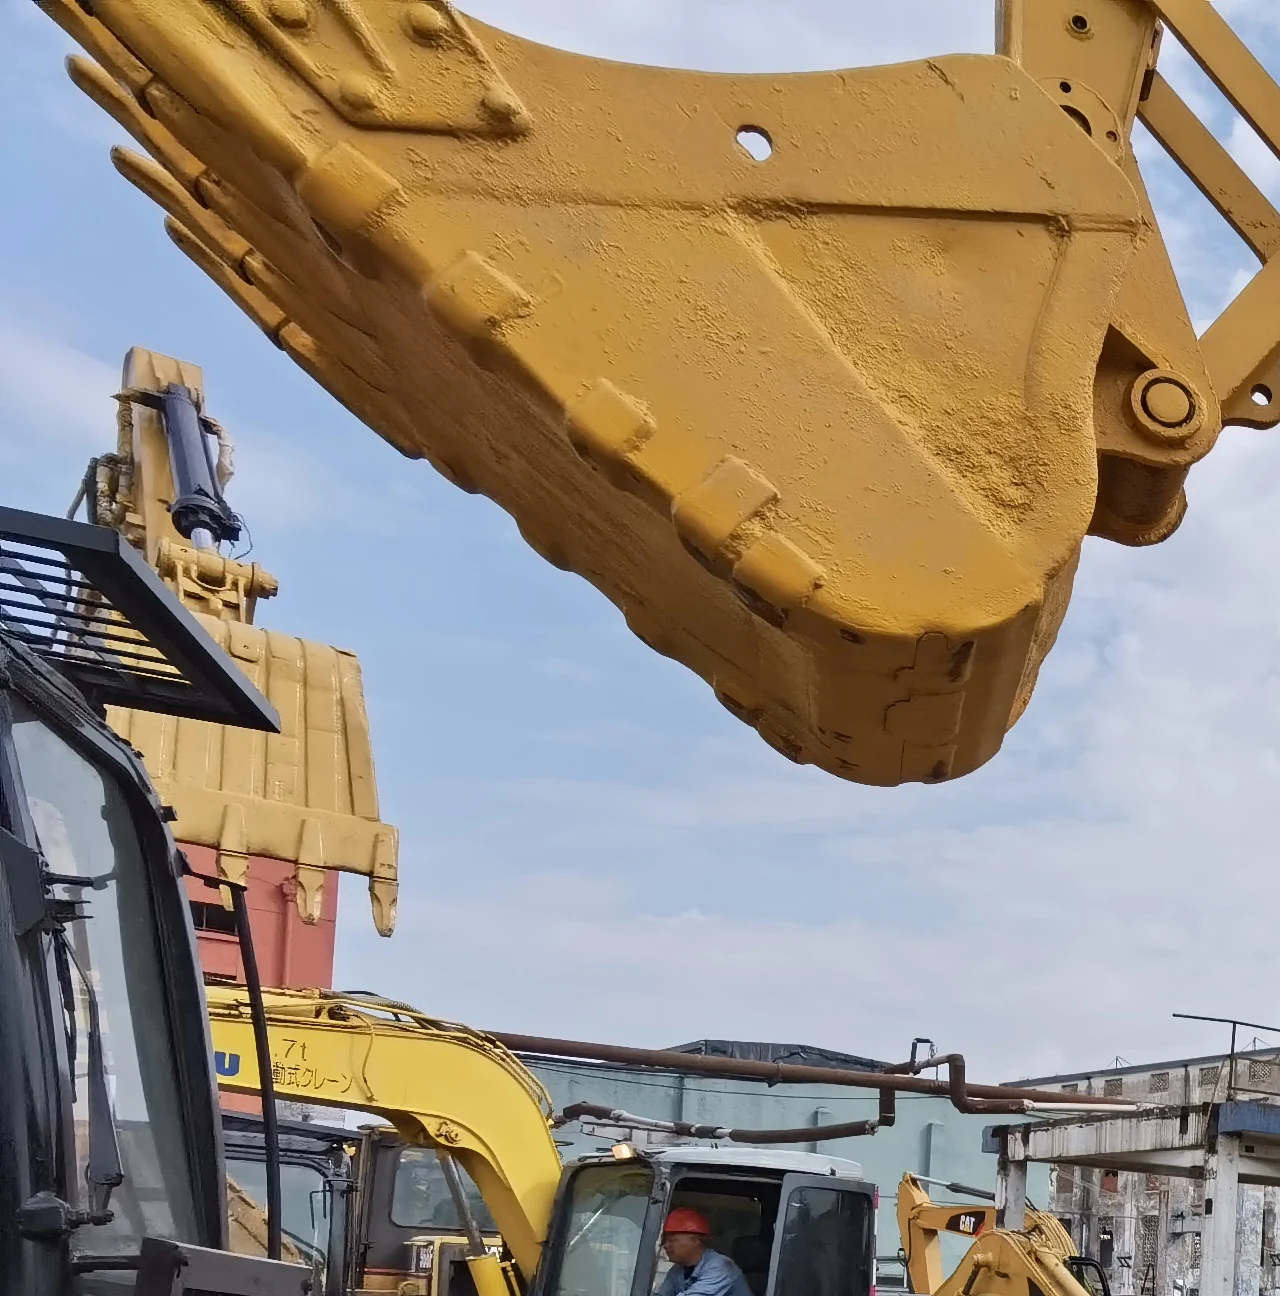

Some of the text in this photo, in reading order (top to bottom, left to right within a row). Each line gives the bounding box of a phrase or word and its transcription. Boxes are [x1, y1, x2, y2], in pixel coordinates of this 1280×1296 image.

[274, 1039, 307, 1061] .7t
[272, 1061, 353, 1093] 動式クレーン
[960, 1215, 975, 1233] CAT
